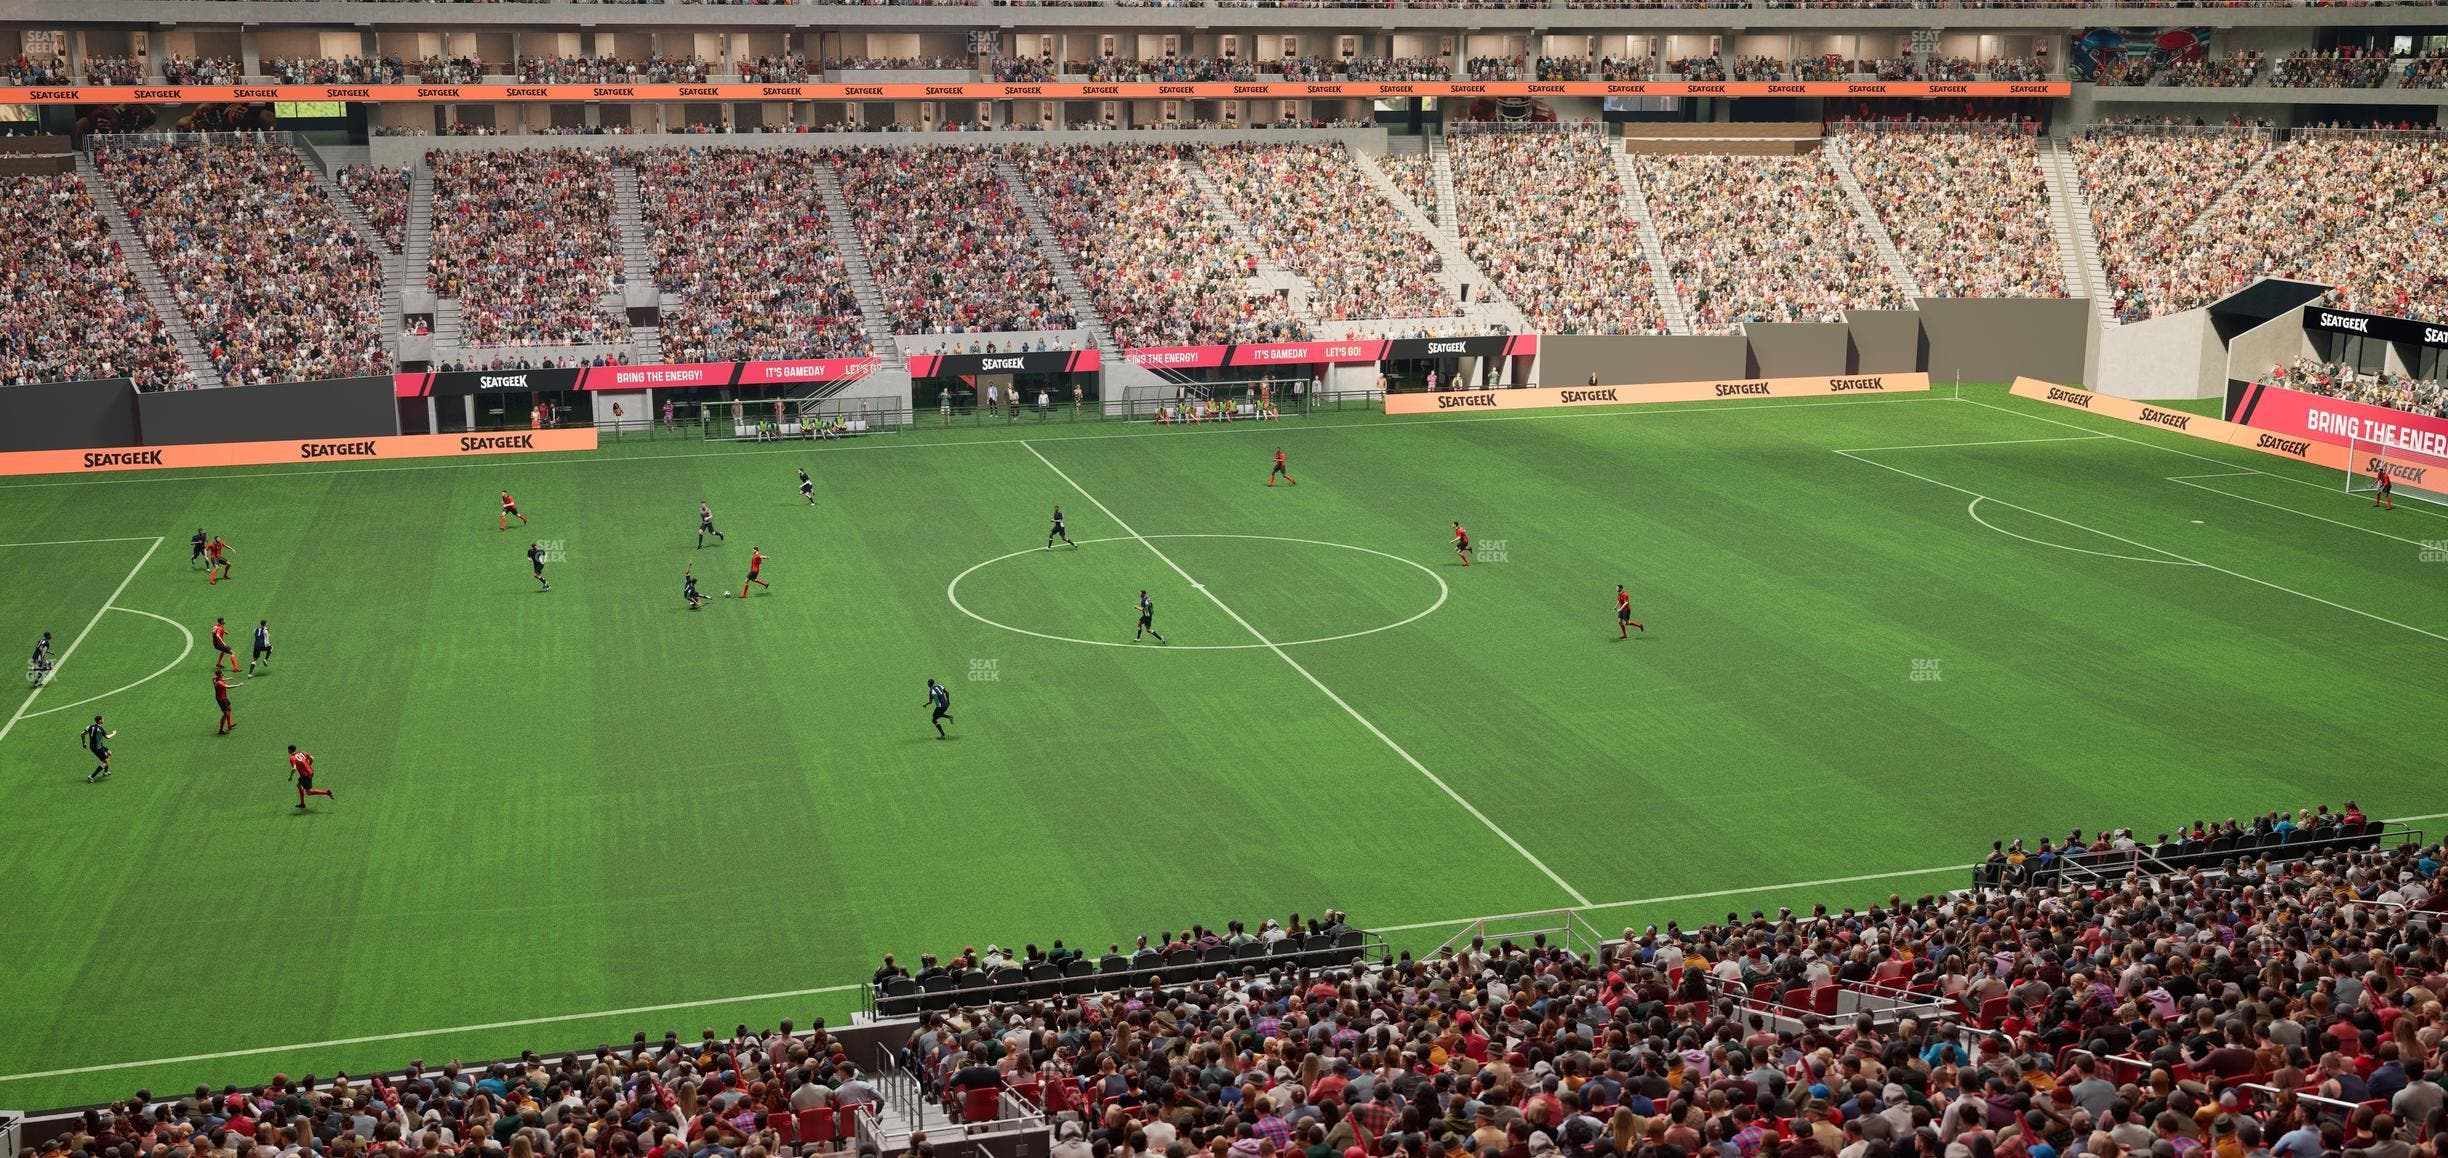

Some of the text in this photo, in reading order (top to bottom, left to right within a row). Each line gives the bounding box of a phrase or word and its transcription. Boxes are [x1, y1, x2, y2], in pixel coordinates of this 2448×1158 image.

[233, 88, 279, 98] SEATGEEK
[326, 88, 370, 98] SEATGEEK
[417, 88, 460, 98] SEATGEEK
[506, 88, 548, 97] SEATGEEK
[593, 87, 634, 97] SEATGEEK
[678, 87, 719, 96] SEATGEEK
[762, 87, 802, 96] SEATGEEK
[845, 87, 883, 96] SEATGEEK
[925, 86, 964, 95] SEATGEEK
[1004, 86, 1042, 95] SEATGEEK
[1082, 86, 1118, 95] SEATGEEK
[1160, 86, 1195, 95] SEATGEEK
[1233, 85, 1269, 94] SEATGEEK
[1307, 85, 1341, 94] SEATGEEK
[1379, 85, 1414, 93] SEATGEEK
[1450, 84, 1486, 93] SEATGEEK
[1527, 84, 1566, 93] SEATGEEK
[1608, 85, 1644, 93] SEATGEEK
[1688, 84, 1726, 93] SEATGEEK
[1767, 85, 1806, 93] SEATGEEK
[1848, 84, 1887, 93] SEATGEEK
[1928, 85, 1968, 93] SEATGEEK
[2009, 85, 2049, 93] SEATGEEK
[29, 90, 80, 100] SEATGEEK
[134, 89, 182, 99] SEATGEEK
[2320, 312, 2369, 333] SEATGEEK
[1325, 346, 1362, 358] LET'S GO!
[1427, 340, 1467, 354] SEATGEEK
[1147, 353, 1164, 363] THE
[1165, 352, 1198, 363] ENERGY!
[1254, 348, 1308, 360] IT'S GAMEDAY
[982, 356, 1025, 371] SEATGEEK
[765, 365, 825, 378] IT'S GAMEDAY
[480, 374, 528, 389] SEATGEEK
[616, 370, 703, 384] BRING THE ENERGY!
[1715, 381, 1771, 397] SEATGEEK
[1829, 377, 1884, 392] SEATGEEK
[1438, 393, 1497, 408] SEATGEEK
[1560, 388, 1618, 404] SEATGEEK
[2046, 387, 2094, 409] SEATGEEK
[2138, 407, 2191, 432] SEATGEEK
[2307, 409, 2448, 457] BRING THE ENER
[461, 434, 534, 452] SEATGEEK
[2256, 433, 2312, 458] SEATGEEK
[301, 440, 377, 459] SEATGEEK
[84, 449, 163, 468] SEATGEEK
[2365, 457, 2427, 484] SEATGEEK
